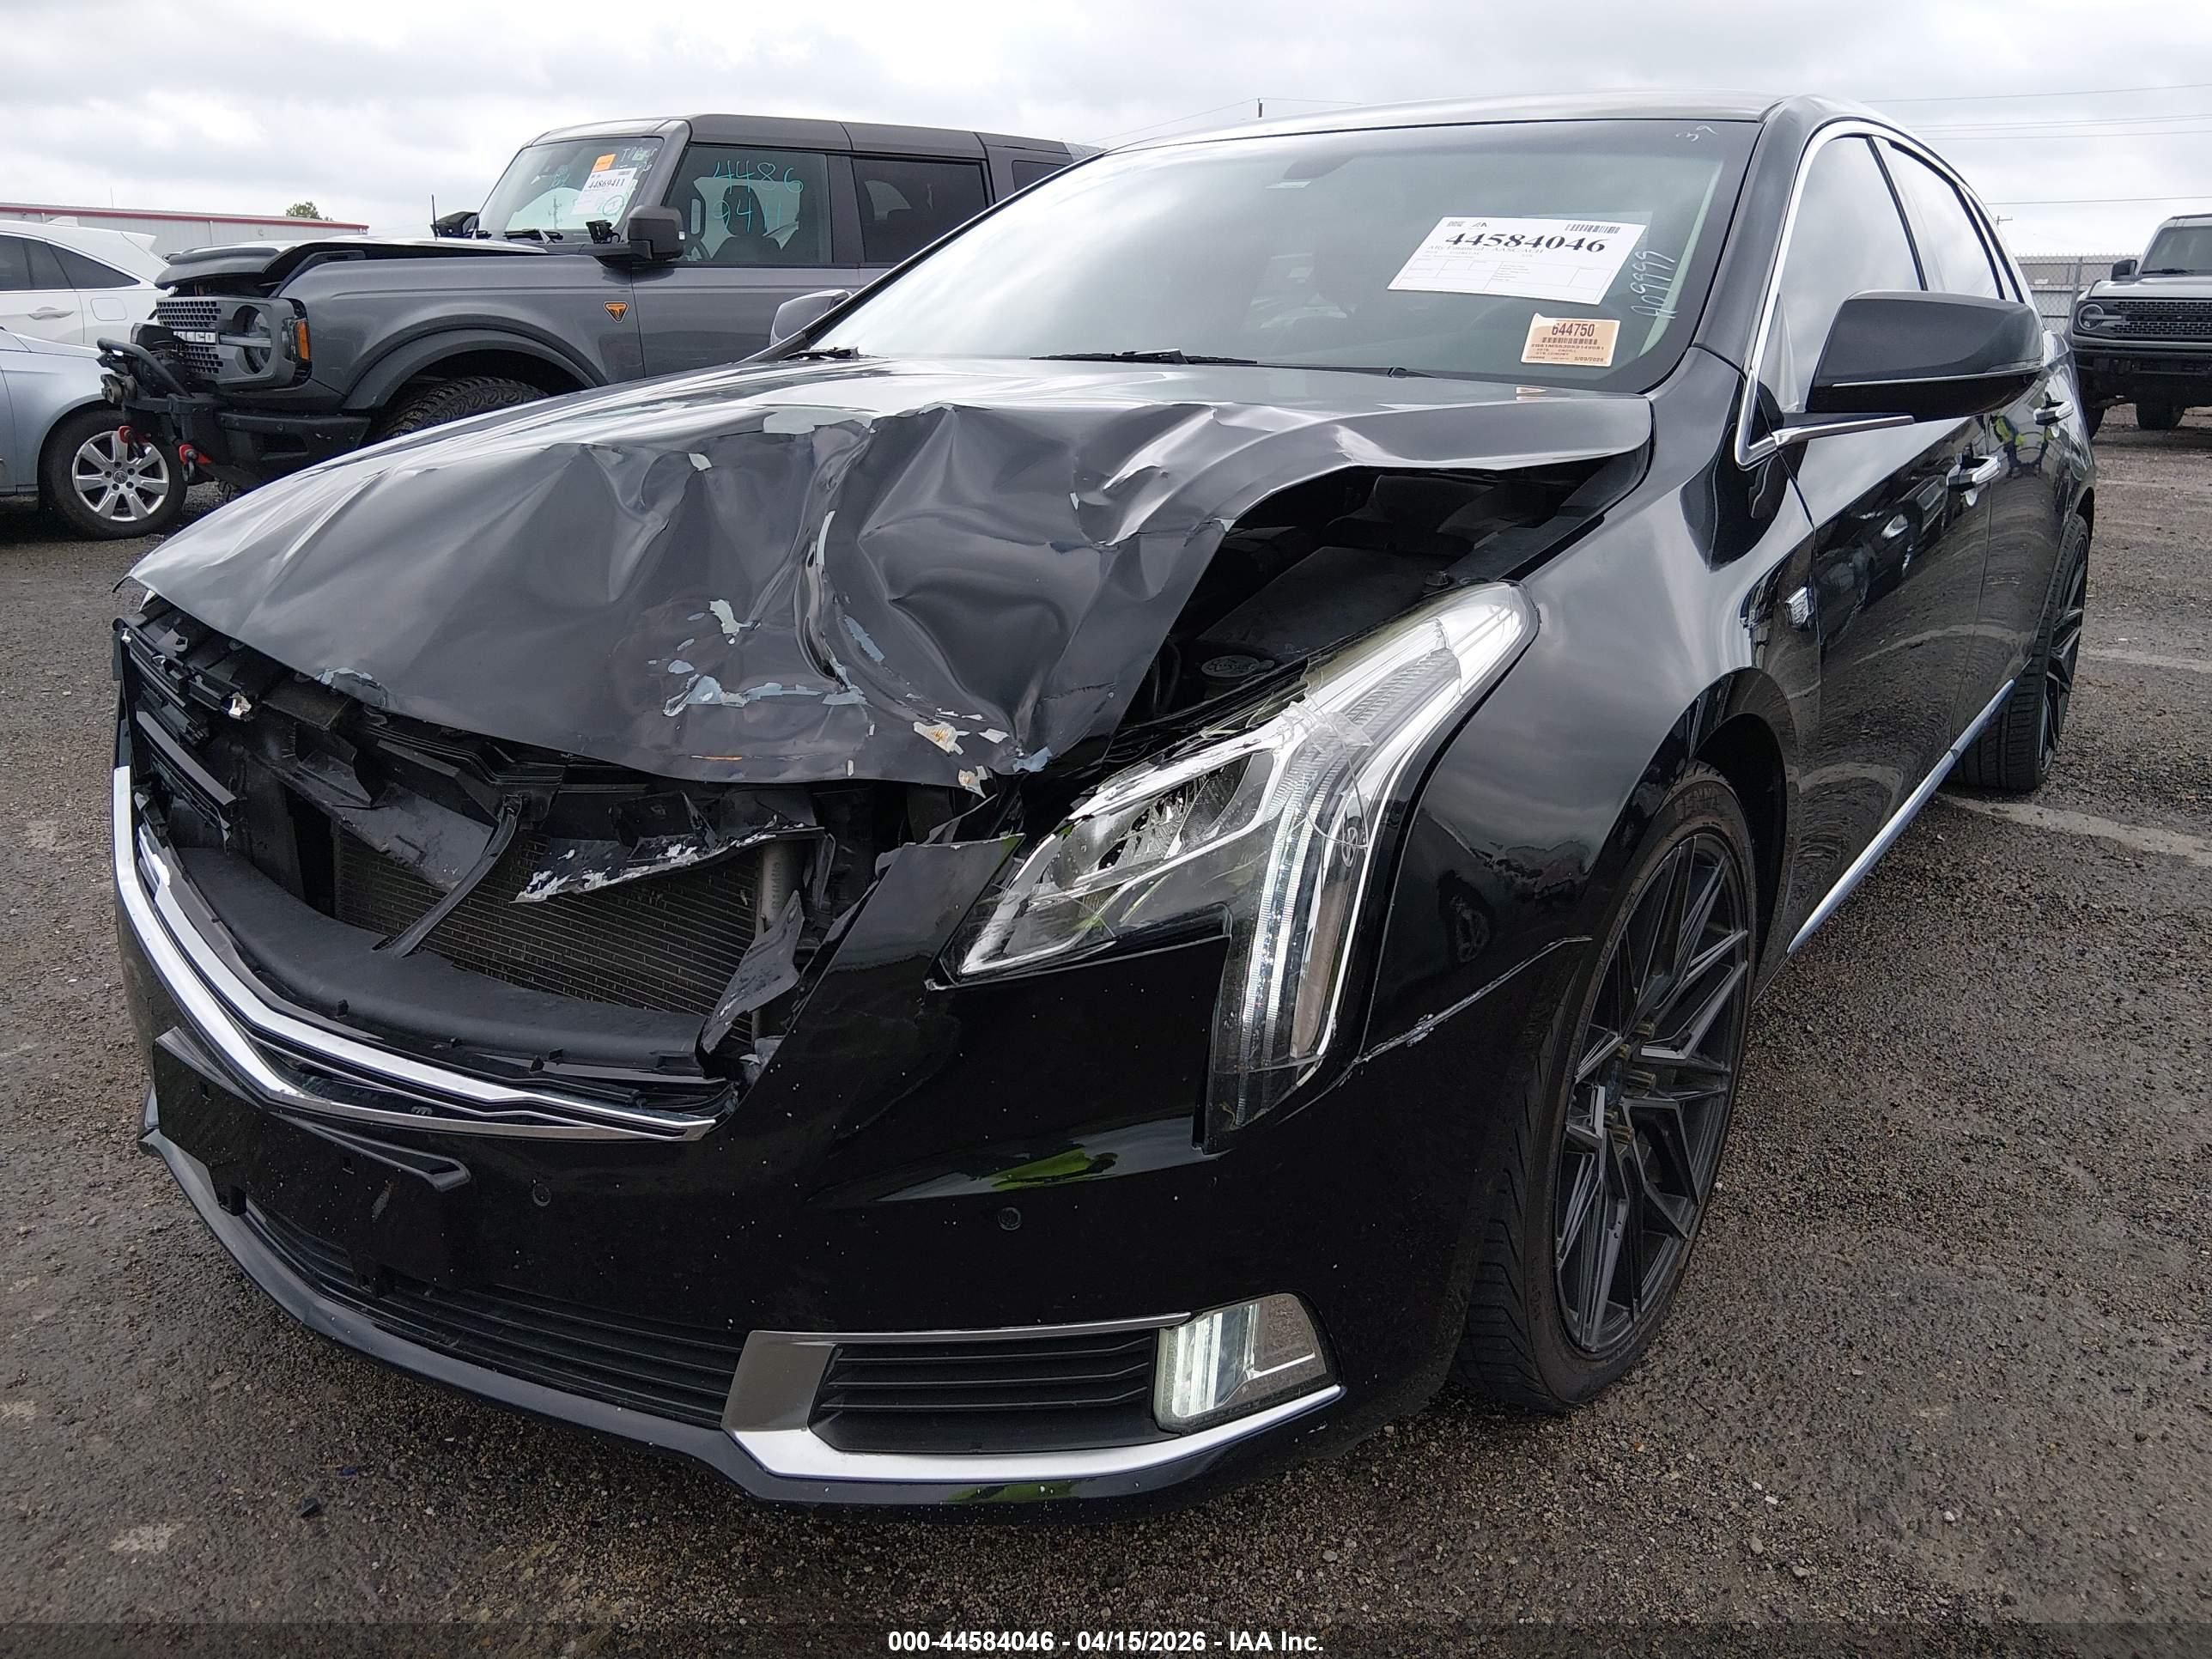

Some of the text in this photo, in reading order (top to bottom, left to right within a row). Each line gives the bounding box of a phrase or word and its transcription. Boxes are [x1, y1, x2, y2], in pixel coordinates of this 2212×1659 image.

[713, 160, 804, 194] 4486
[713, 198, 782, 234] 9411
[1445, 233, 1611, 253] 44584046
[1552, 322, 1595, 337] 644750
